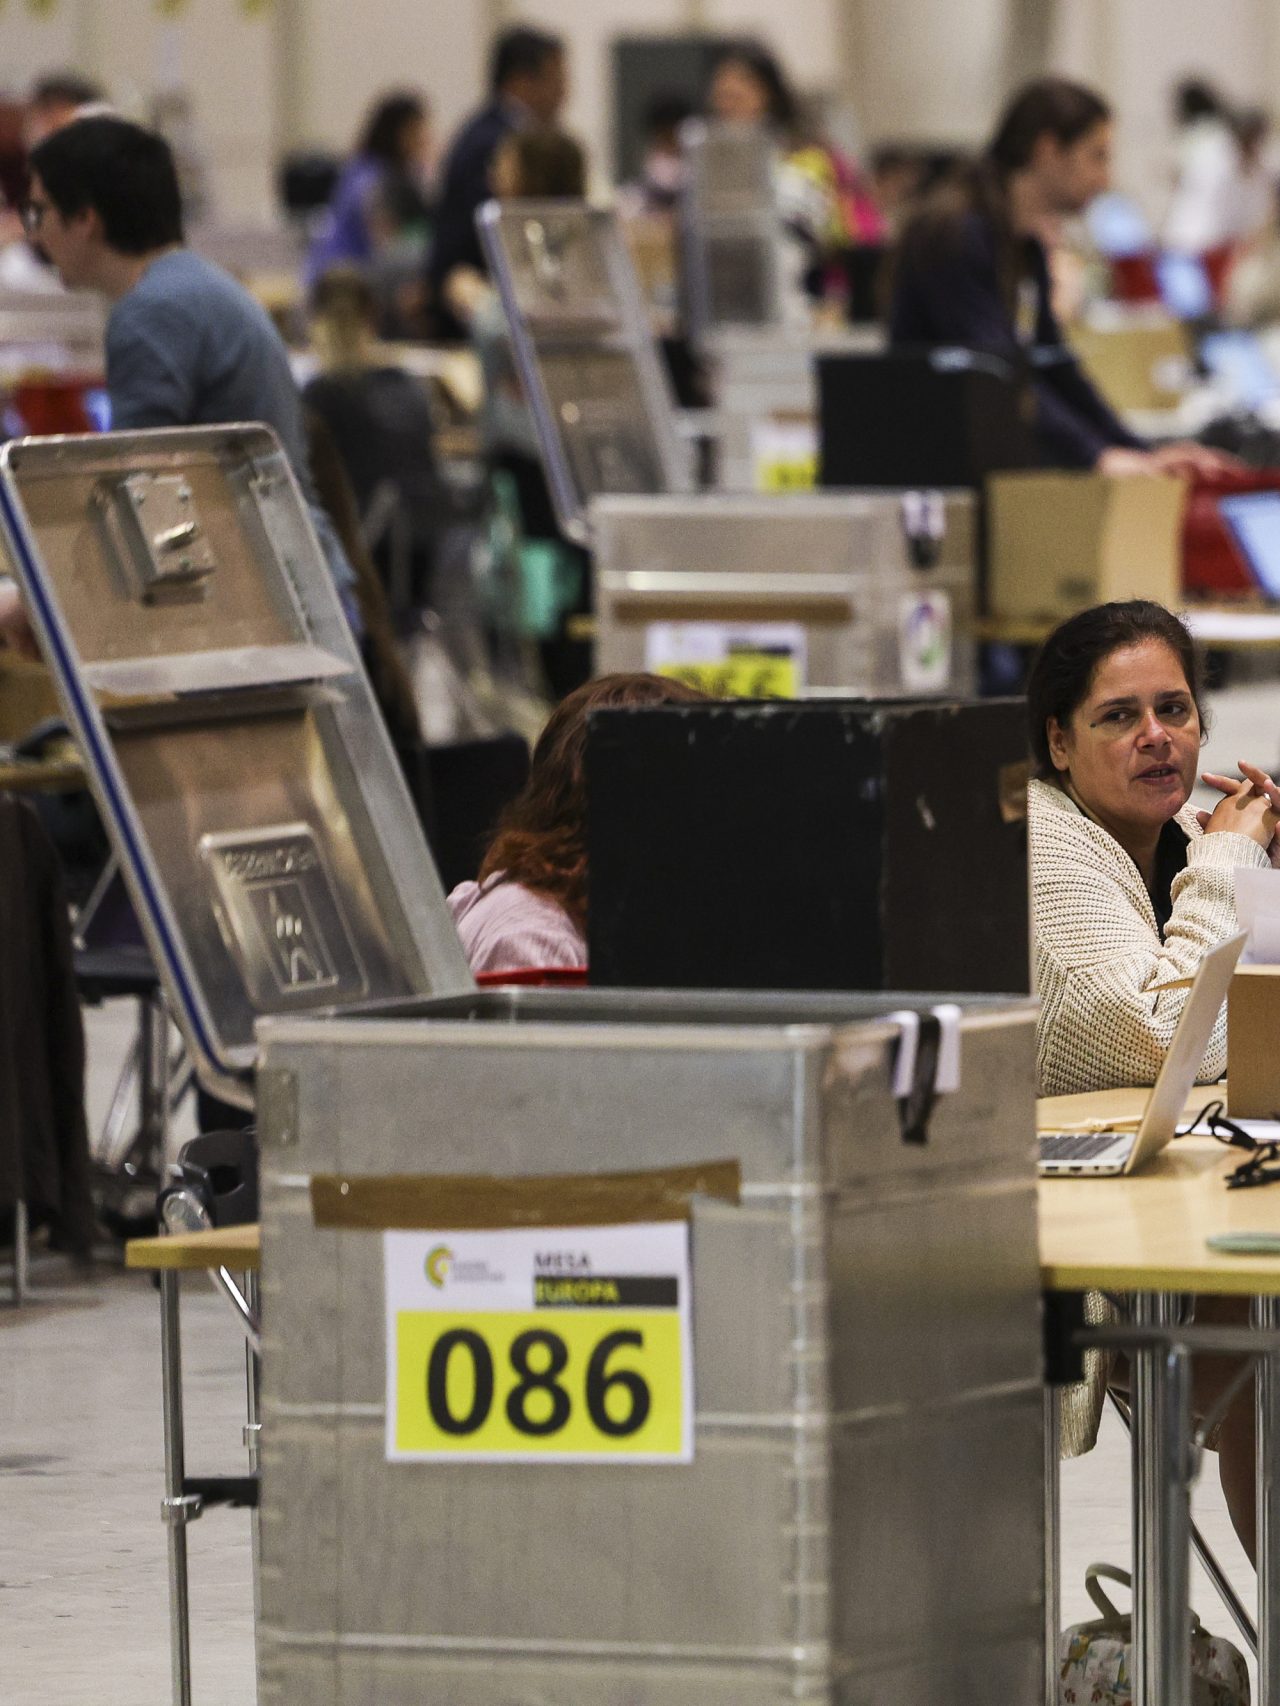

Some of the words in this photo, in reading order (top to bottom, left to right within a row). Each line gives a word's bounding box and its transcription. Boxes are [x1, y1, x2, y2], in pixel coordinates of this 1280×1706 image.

[534, 1253, 592, 1268] MESA
[535, 1279, 619, 1301] EUROPA
[426, 1327, 652, 1438] 086
